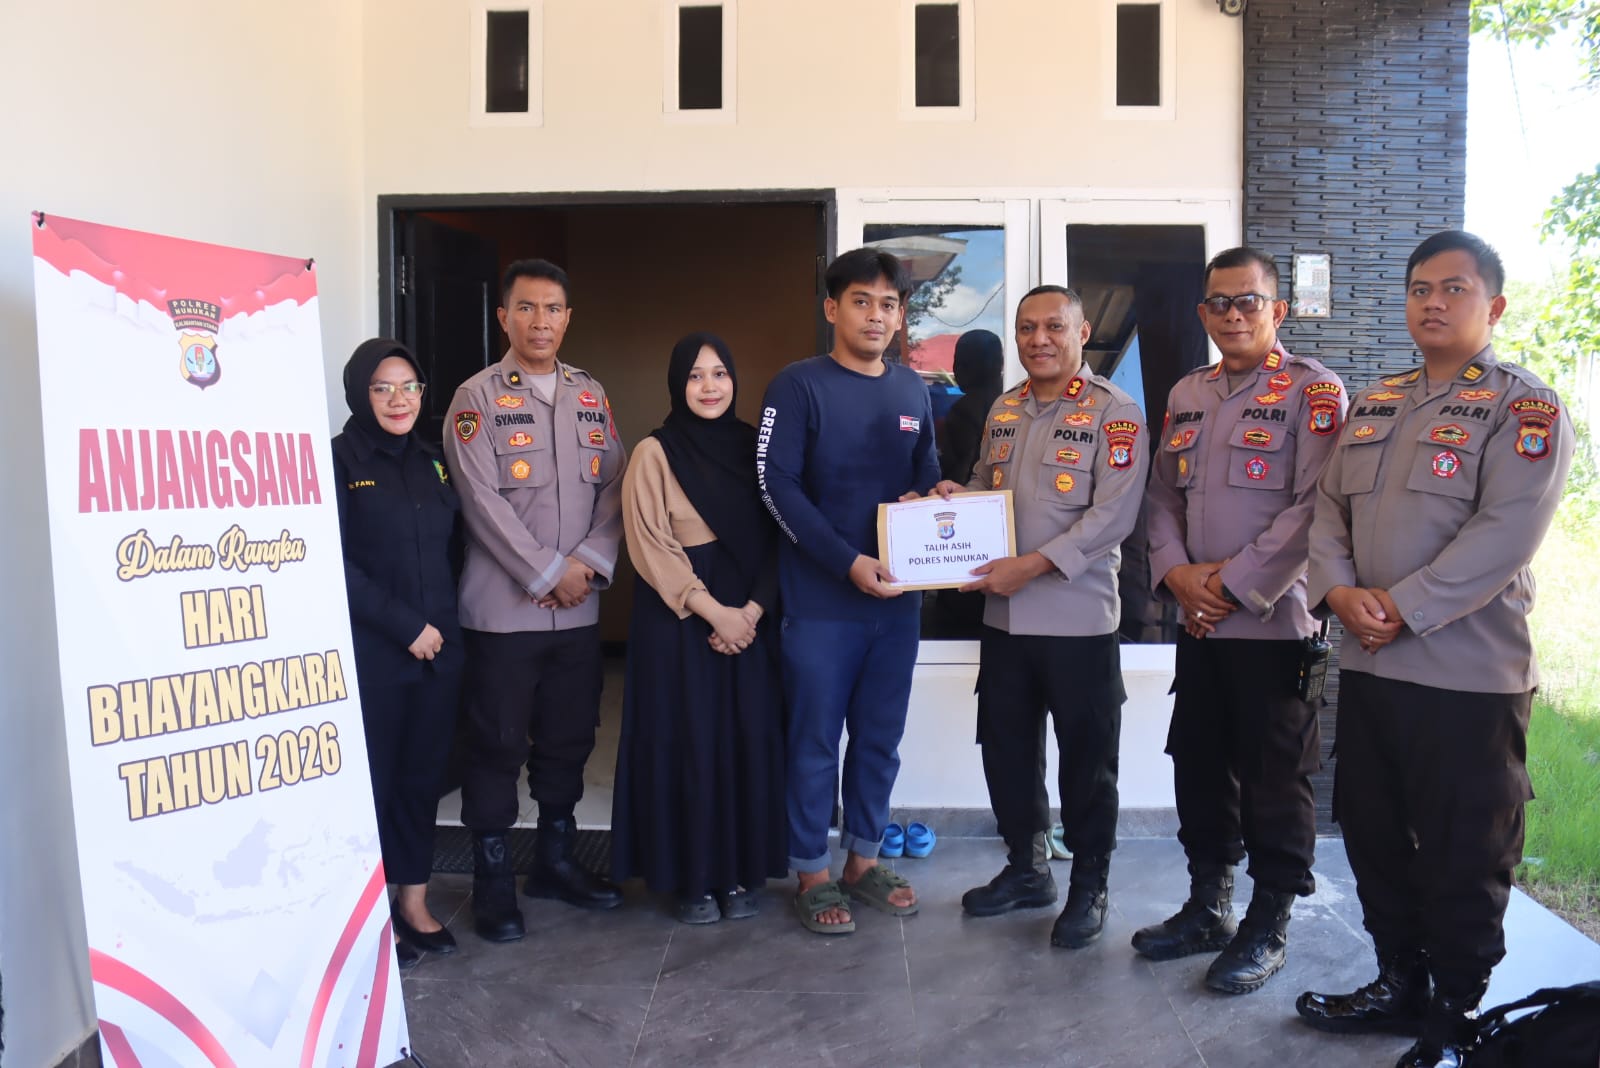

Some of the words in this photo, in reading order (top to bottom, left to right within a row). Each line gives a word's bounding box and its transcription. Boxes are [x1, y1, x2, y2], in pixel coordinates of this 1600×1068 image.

[172, 300, 217, 312] POLRES
[174, 307, 217, 319] NUNUKAN
[1242, 408, 1287, 422] POLRI
[1439, 405, 1491, 420] POLRI
[495, 413, 535, 427] SYAHRIR
[1053, 429, 1093, 443] POLRI
[78, 428, 322, 513] ANJANGSANA
[116, 528, 215, 582] Dalam
[218, 524, 306, 573] Rangka
[924, 543, 949, 552] TALIH
[951, 541, 971, 551] ASIH
[908, 556, 941, 565] POLRES
[943, 553, 989, 563] NUNUKAN
[180, 584, 268, 649] HARI
[87, 649, 347, 747] BHAYANGKARA
[118, 740, 252, 822] TAHUN
[255, 721, 341, 792] 2026
